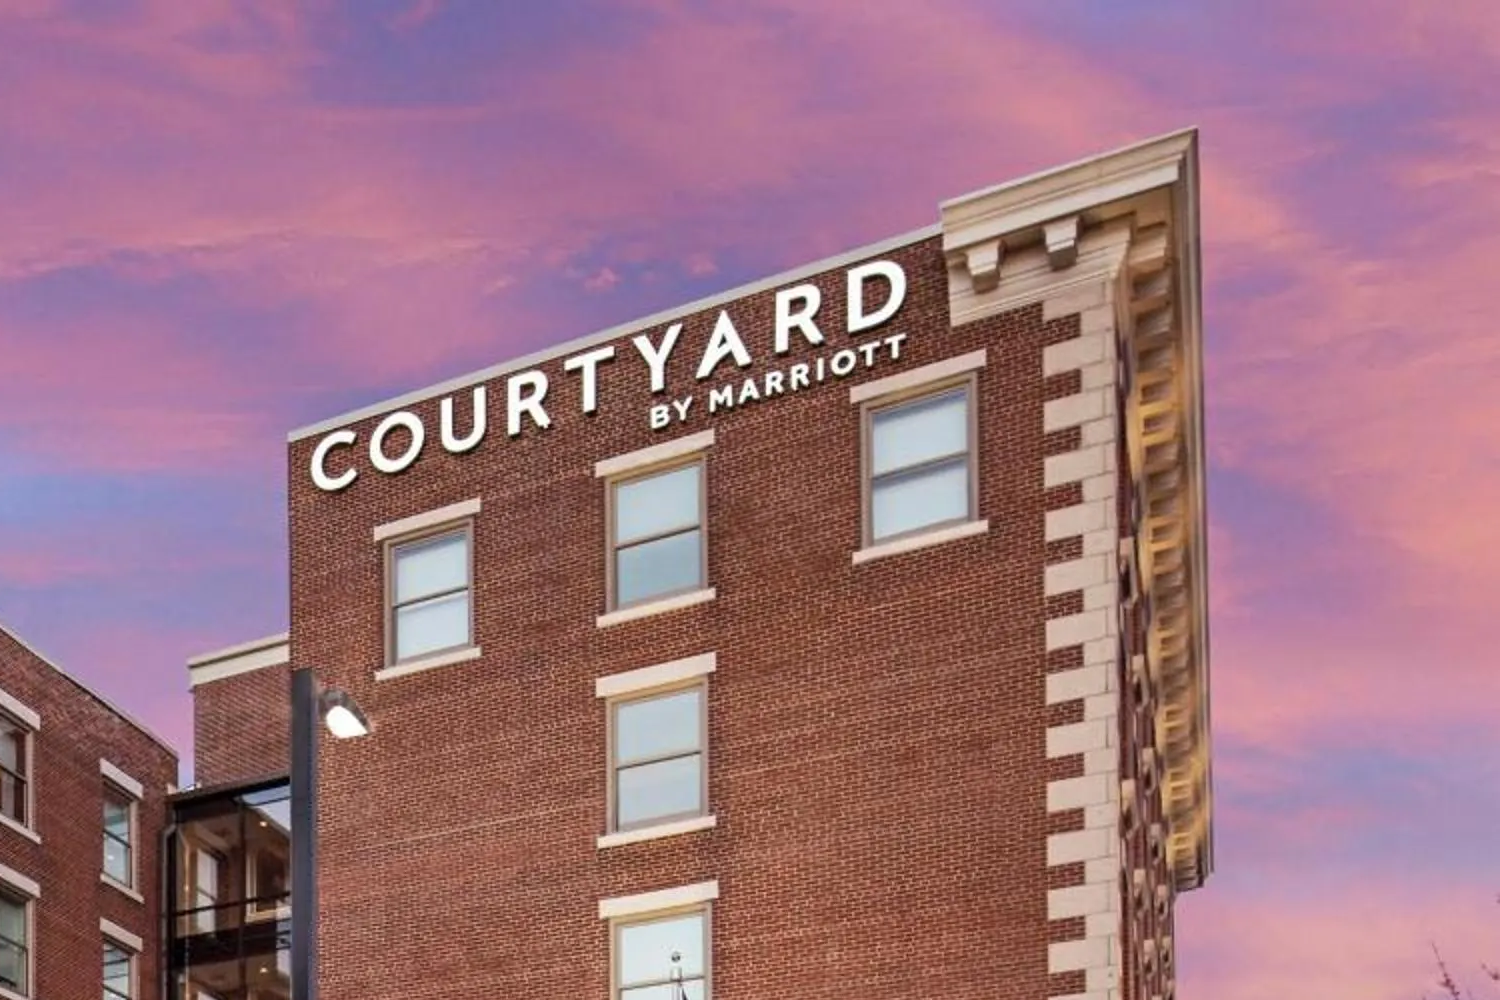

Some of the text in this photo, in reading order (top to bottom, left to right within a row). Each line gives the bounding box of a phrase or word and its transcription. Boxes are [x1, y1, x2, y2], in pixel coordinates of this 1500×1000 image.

[310, 260, 906, 491] COURTYARD
[650, 334, 906, 430] BY MARRIOTT
